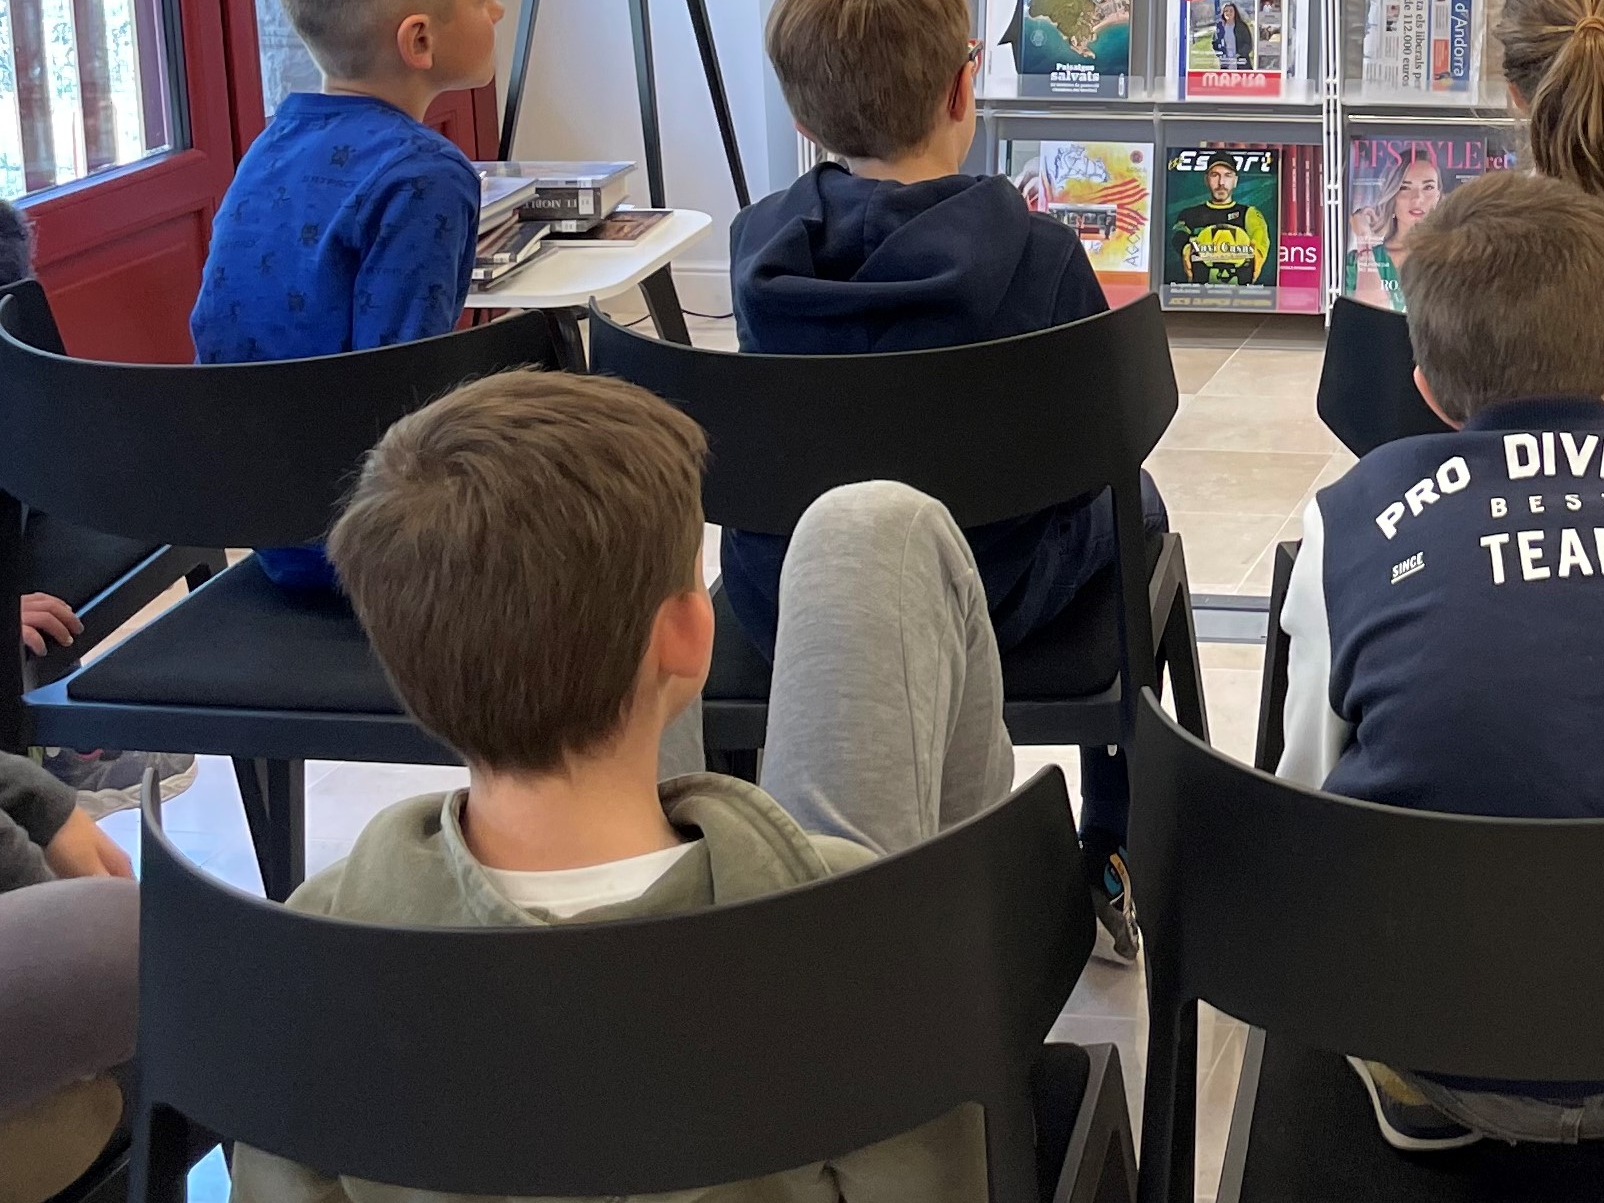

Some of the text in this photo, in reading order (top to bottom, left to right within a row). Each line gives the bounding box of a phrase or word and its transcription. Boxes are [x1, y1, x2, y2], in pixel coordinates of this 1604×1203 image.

[1402, 13, 1413, 55] 112.000
[1415, 13, 1426, 28] els
[1414, 30, 1425, 70] liberals
[1050, 71, 1100, 81] salvats
[1402, 57, 1411, 87] euros
[1375, 456, 1471, 540] PRO
[1392, 551, 1425, 578] SINCE
